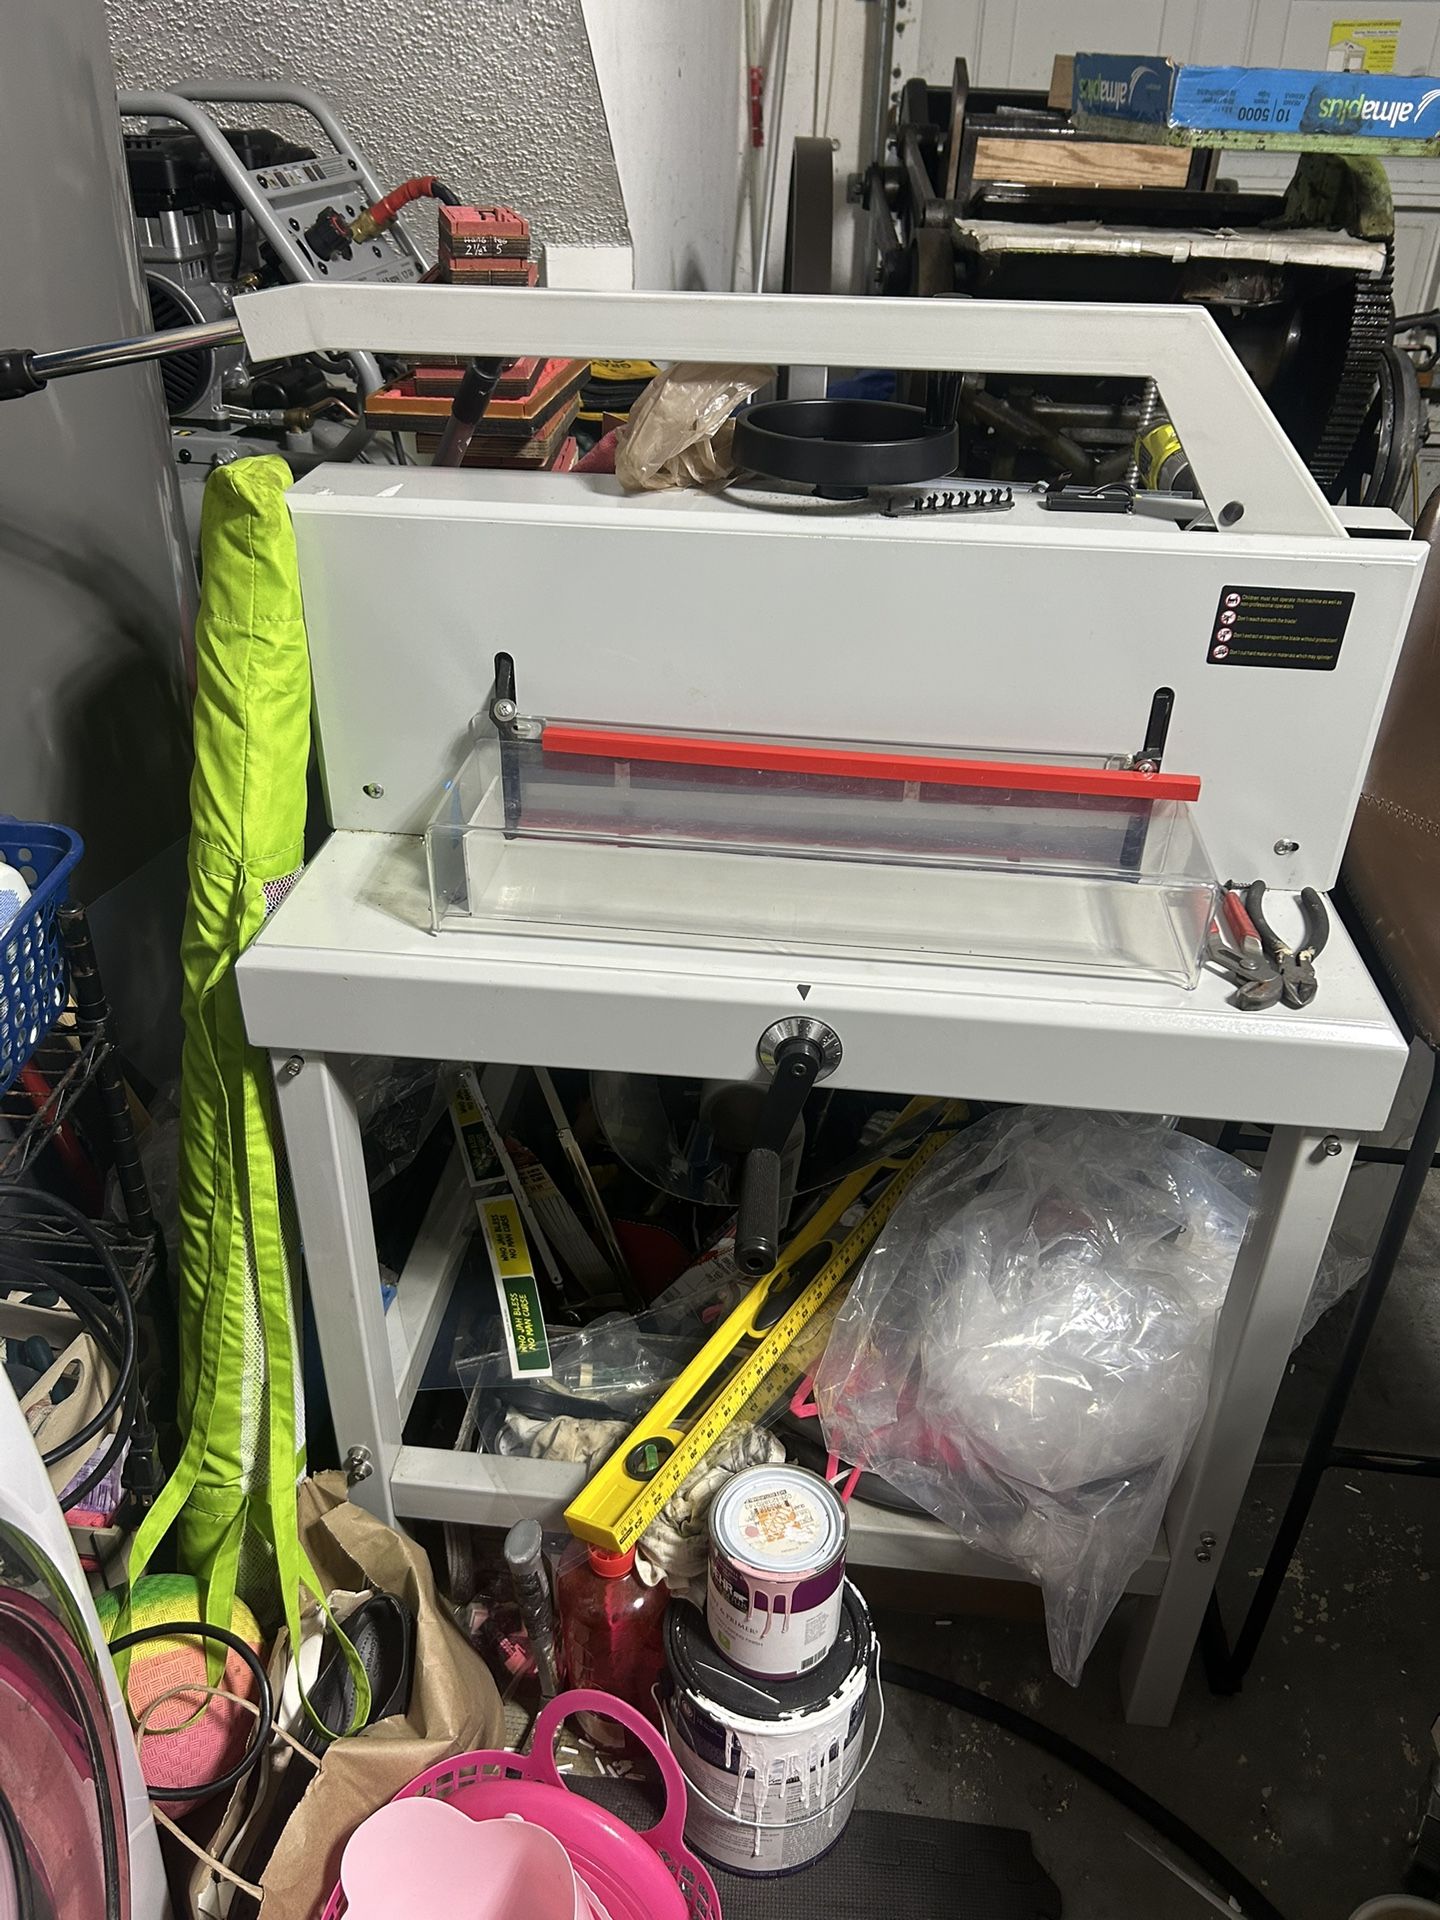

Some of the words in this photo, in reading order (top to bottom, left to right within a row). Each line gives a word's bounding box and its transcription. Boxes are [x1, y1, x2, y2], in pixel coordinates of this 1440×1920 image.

[1238, 106, 1270, 122] 5000
[1276, 108, 1290, 122] 10
[1318, 94, 1414, 128] almaplus
[510, 1292, 522, 1315] BLESS
[519, 1294, 530, 1317] CURSE
[516, 1318, 525, 1333] JAH
[524, 1318, 534, 1336] MAN
[527, 1337, 537, 1351] NO
[756, 1367, 763, 1376] 16
[741, 1386, 747, 1396] 17
[724, 1407, 731, 1417] 18
[707, 1428, 714, 1438] 19
[690, 1449, 697, 1460] 20
[673, 1470, 681, 1480] 21
[654, 1493, 662, 1505] 22
[635, 1516, 643, 1529] 23
